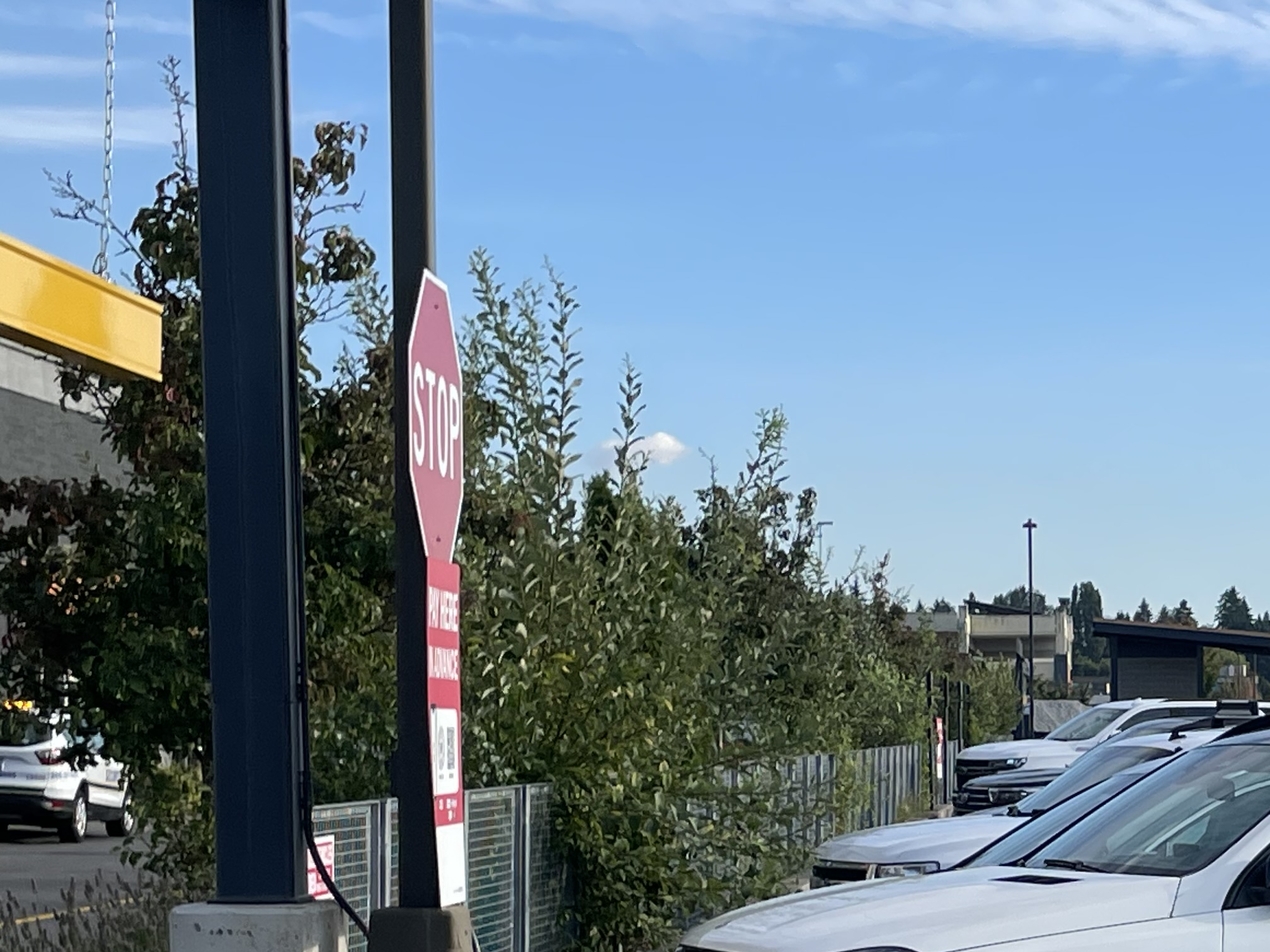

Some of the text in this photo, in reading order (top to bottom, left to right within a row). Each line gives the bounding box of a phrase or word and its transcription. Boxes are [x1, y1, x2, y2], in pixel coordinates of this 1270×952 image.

[413, 361, 460, 480] STOP
[428, 586, 459, 632] PAY HERE
